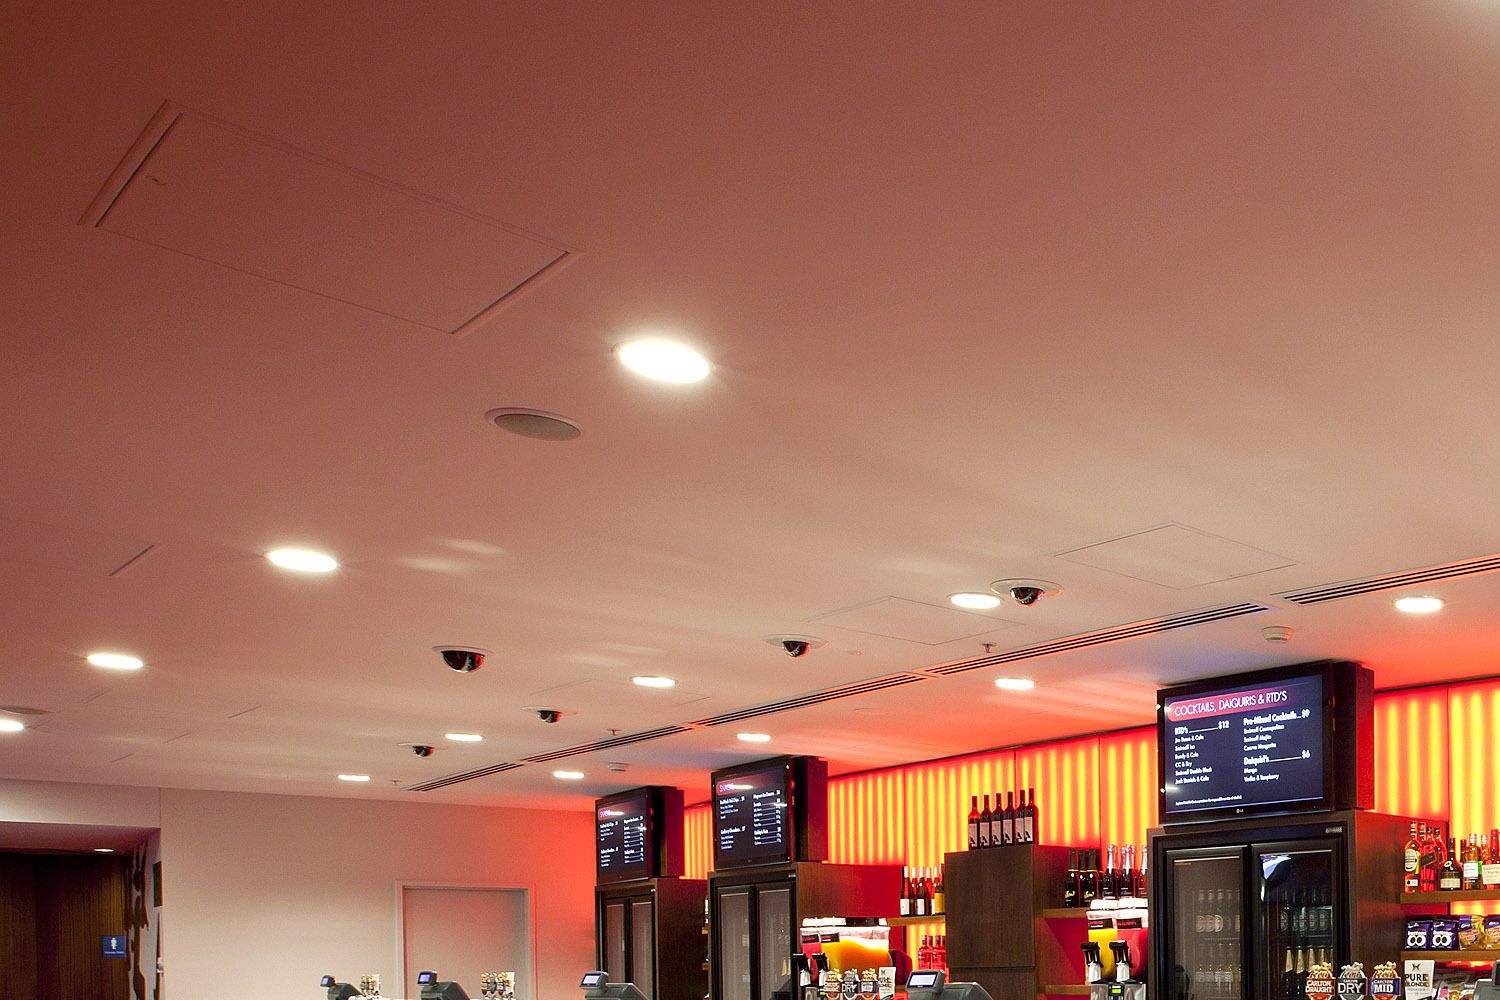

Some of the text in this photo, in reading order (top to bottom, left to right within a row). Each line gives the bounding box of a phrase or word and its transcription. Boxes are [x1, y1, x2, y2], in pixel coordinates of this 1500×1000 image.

[842, 984, 857, 992] DRY
[1338, 983, 1364, 994] DRY
[1374, 983, 1393, 993] MID
